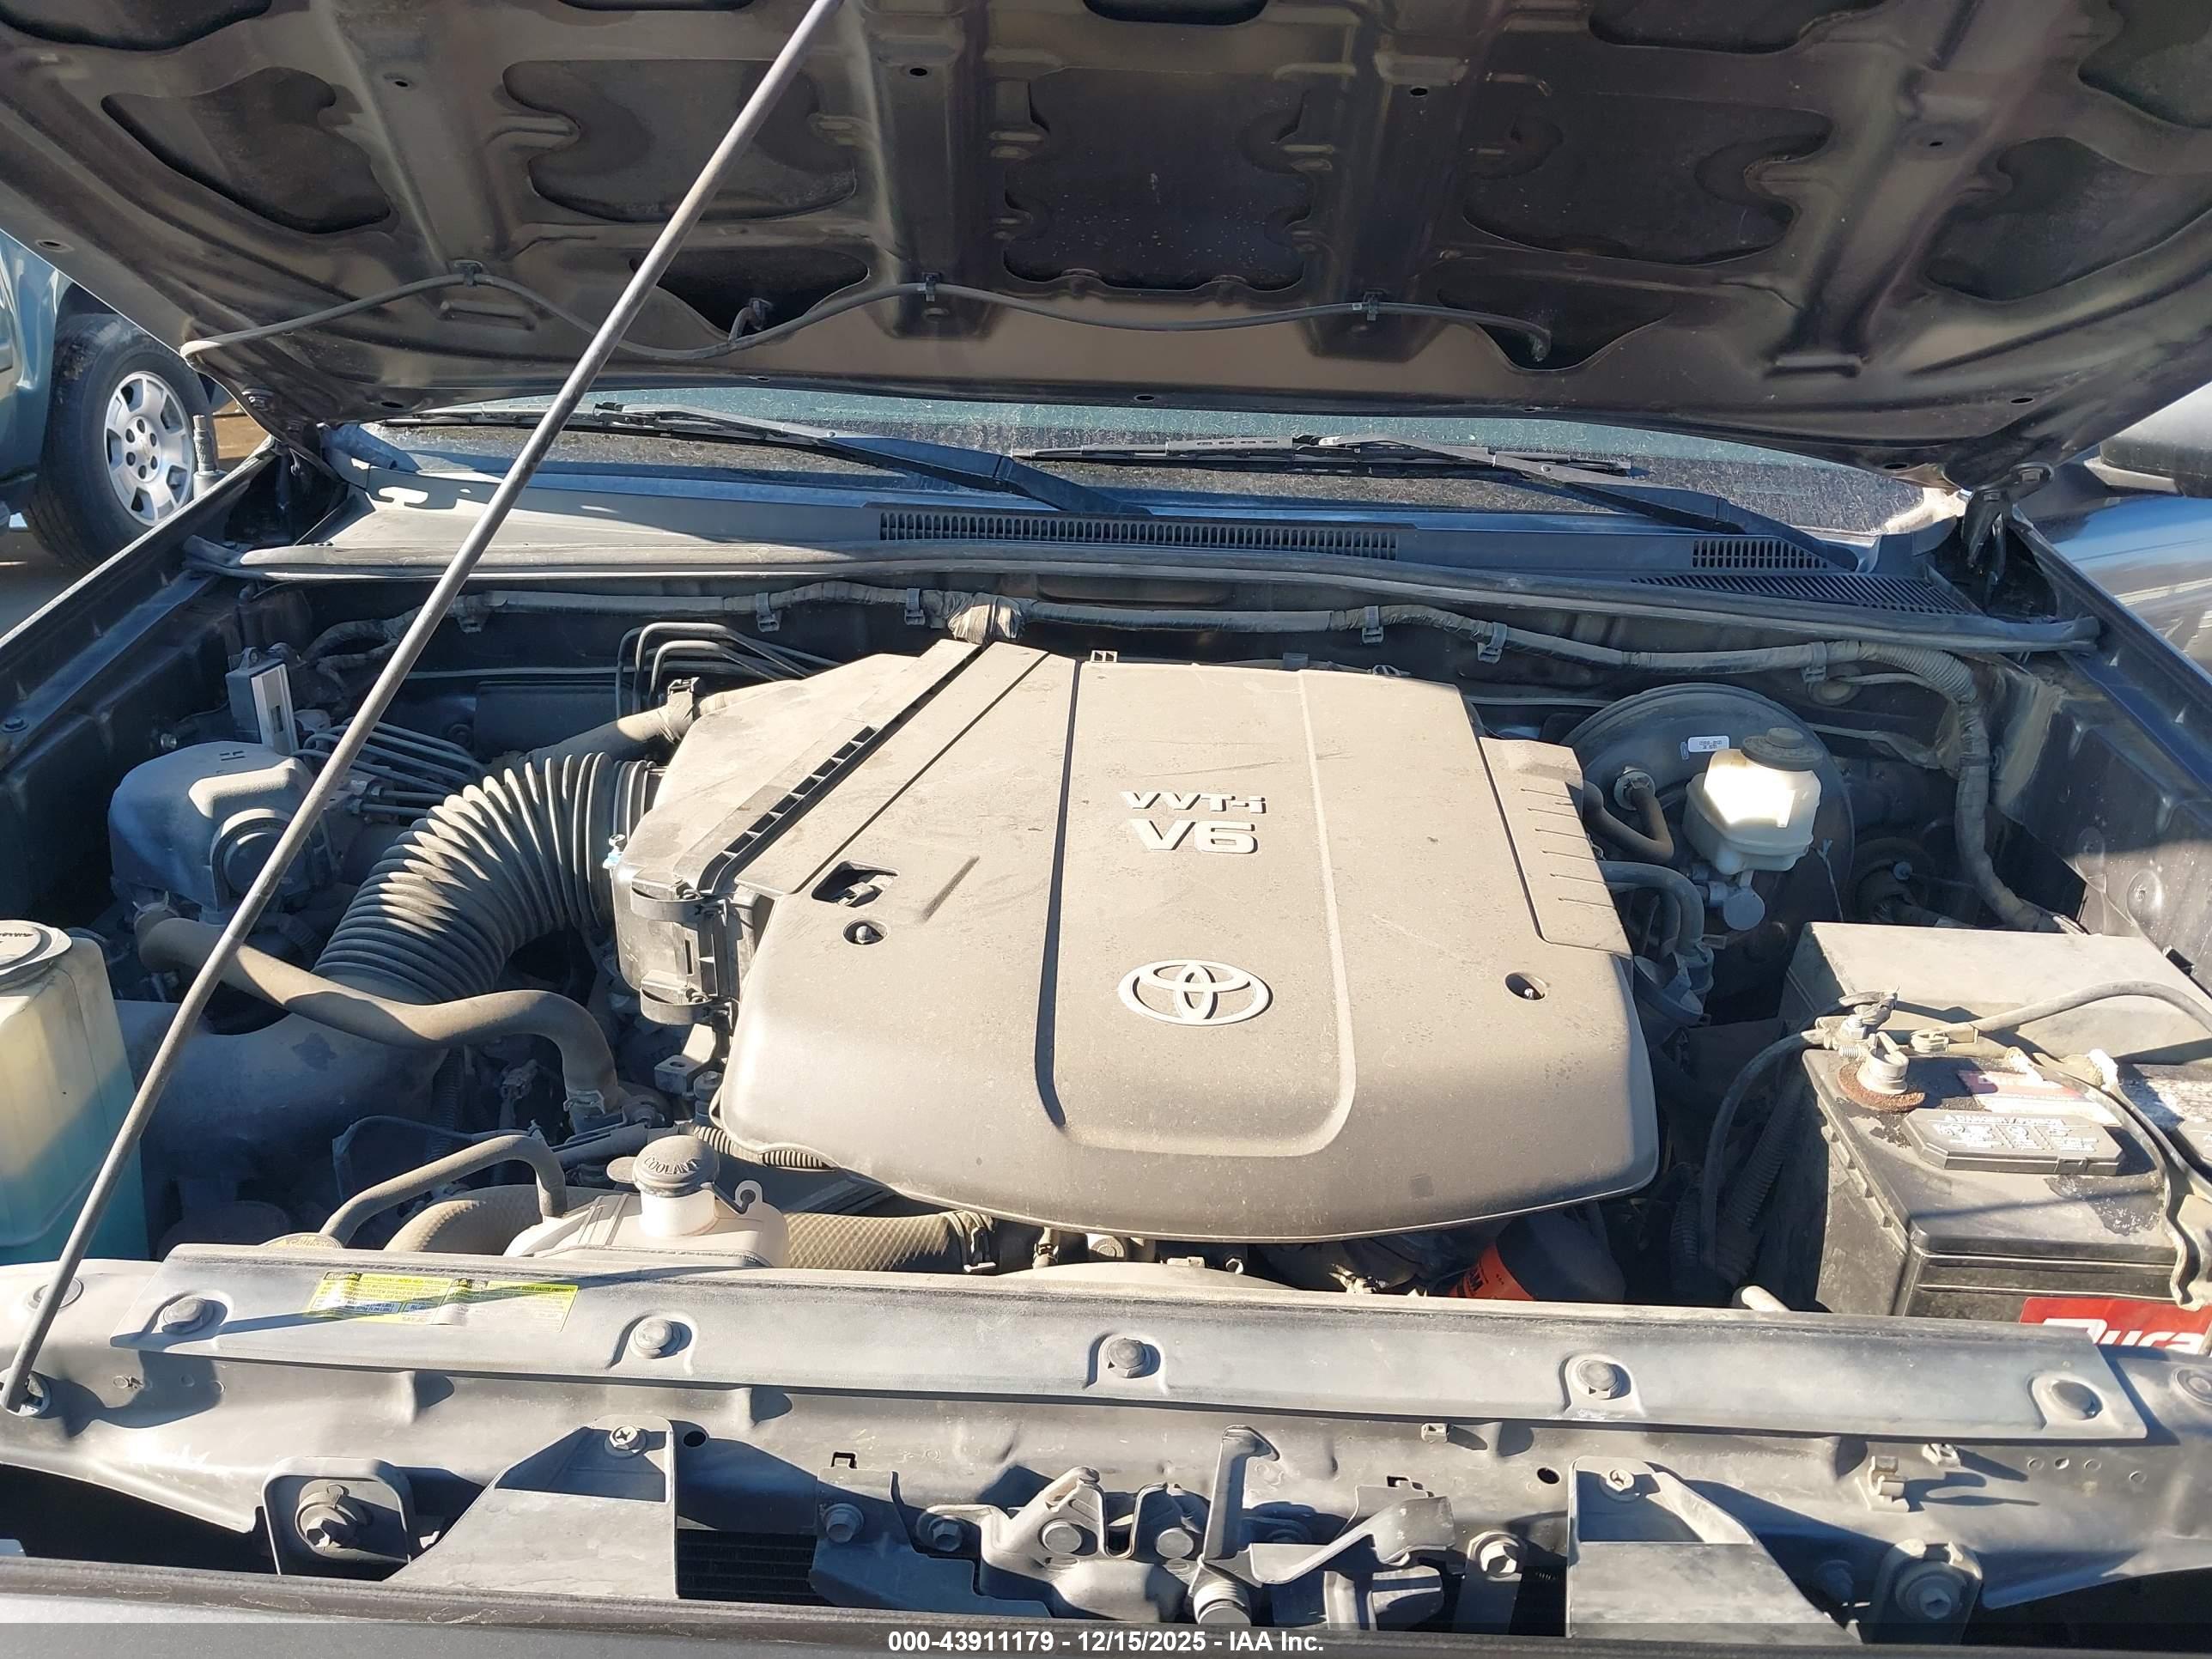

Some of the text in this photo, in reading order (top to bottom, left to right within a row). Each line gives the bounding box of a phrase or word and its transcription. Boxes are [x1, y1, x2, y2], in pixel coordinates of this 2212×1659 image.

[1120, 791, 1267, 814] VVT-i
[1128, 818, 1258, 854] V6
[644, 1156, 702, 1175] COOLANT
